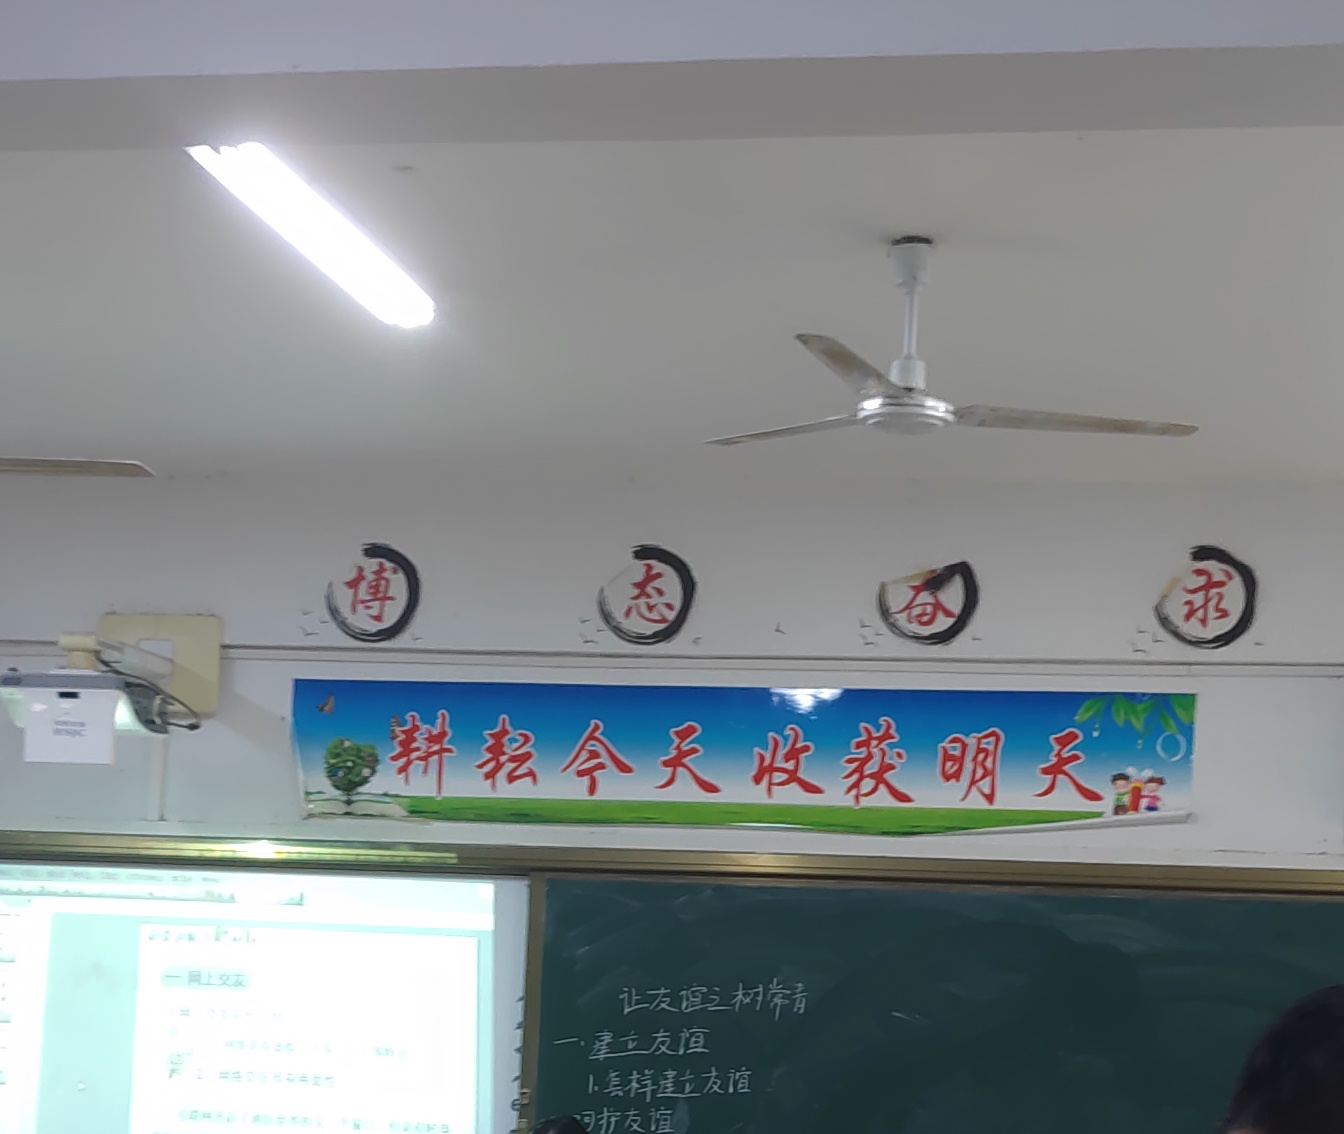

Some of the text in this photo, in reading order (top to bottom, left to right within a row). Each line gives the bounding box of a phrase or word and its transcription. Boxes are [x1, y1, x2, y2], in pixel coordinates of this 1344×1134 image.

[344, 562, 398, 623] 博
[625, 563, 675, 625] 态
[1182, 567, 1235, 628] 求
[389, 704, 1107, 808] 耕耘今天收获明天
[619, 978, 809, 1021] 让友谊之树常青
